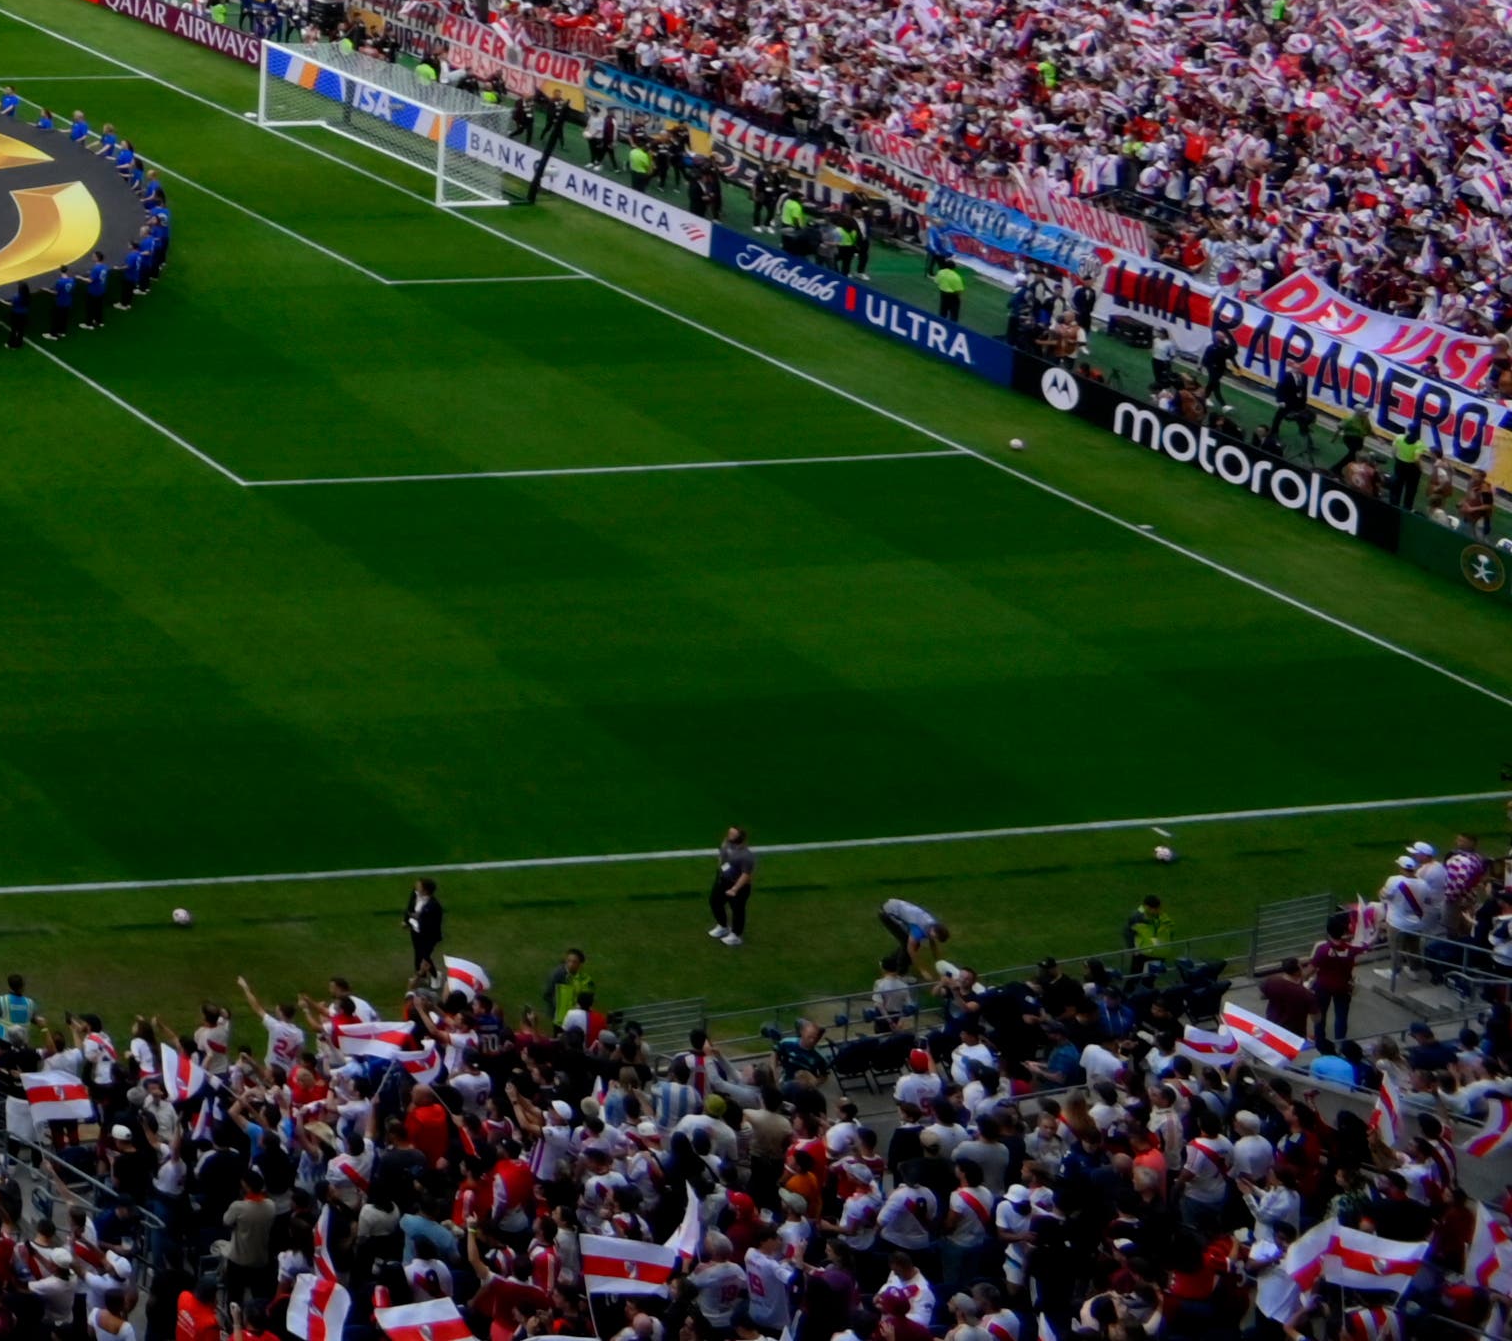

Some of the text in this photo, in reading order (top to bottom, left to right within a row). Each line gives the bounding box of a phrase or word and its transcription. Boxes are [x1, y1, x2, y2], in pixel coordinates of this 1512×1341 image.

[172, 8, 262, 67] AIRWAYS
[442, 12, 507, 63] RIVER
[522, 44, 582, 86] TOUR
[586, 64, 704, 130] CASILDA
[710, 107, 818, 176] EZEIZA
[468, 129, 527, 173] BANK
[564, 172, 672, 233] AMERICA
[735, 242, 838, 304] Michelob
[1112, 258, 1192, 331] LIMA
[864, 292, 973, 366] ULTRA
[1112, 399, 1361, 537] motorola
